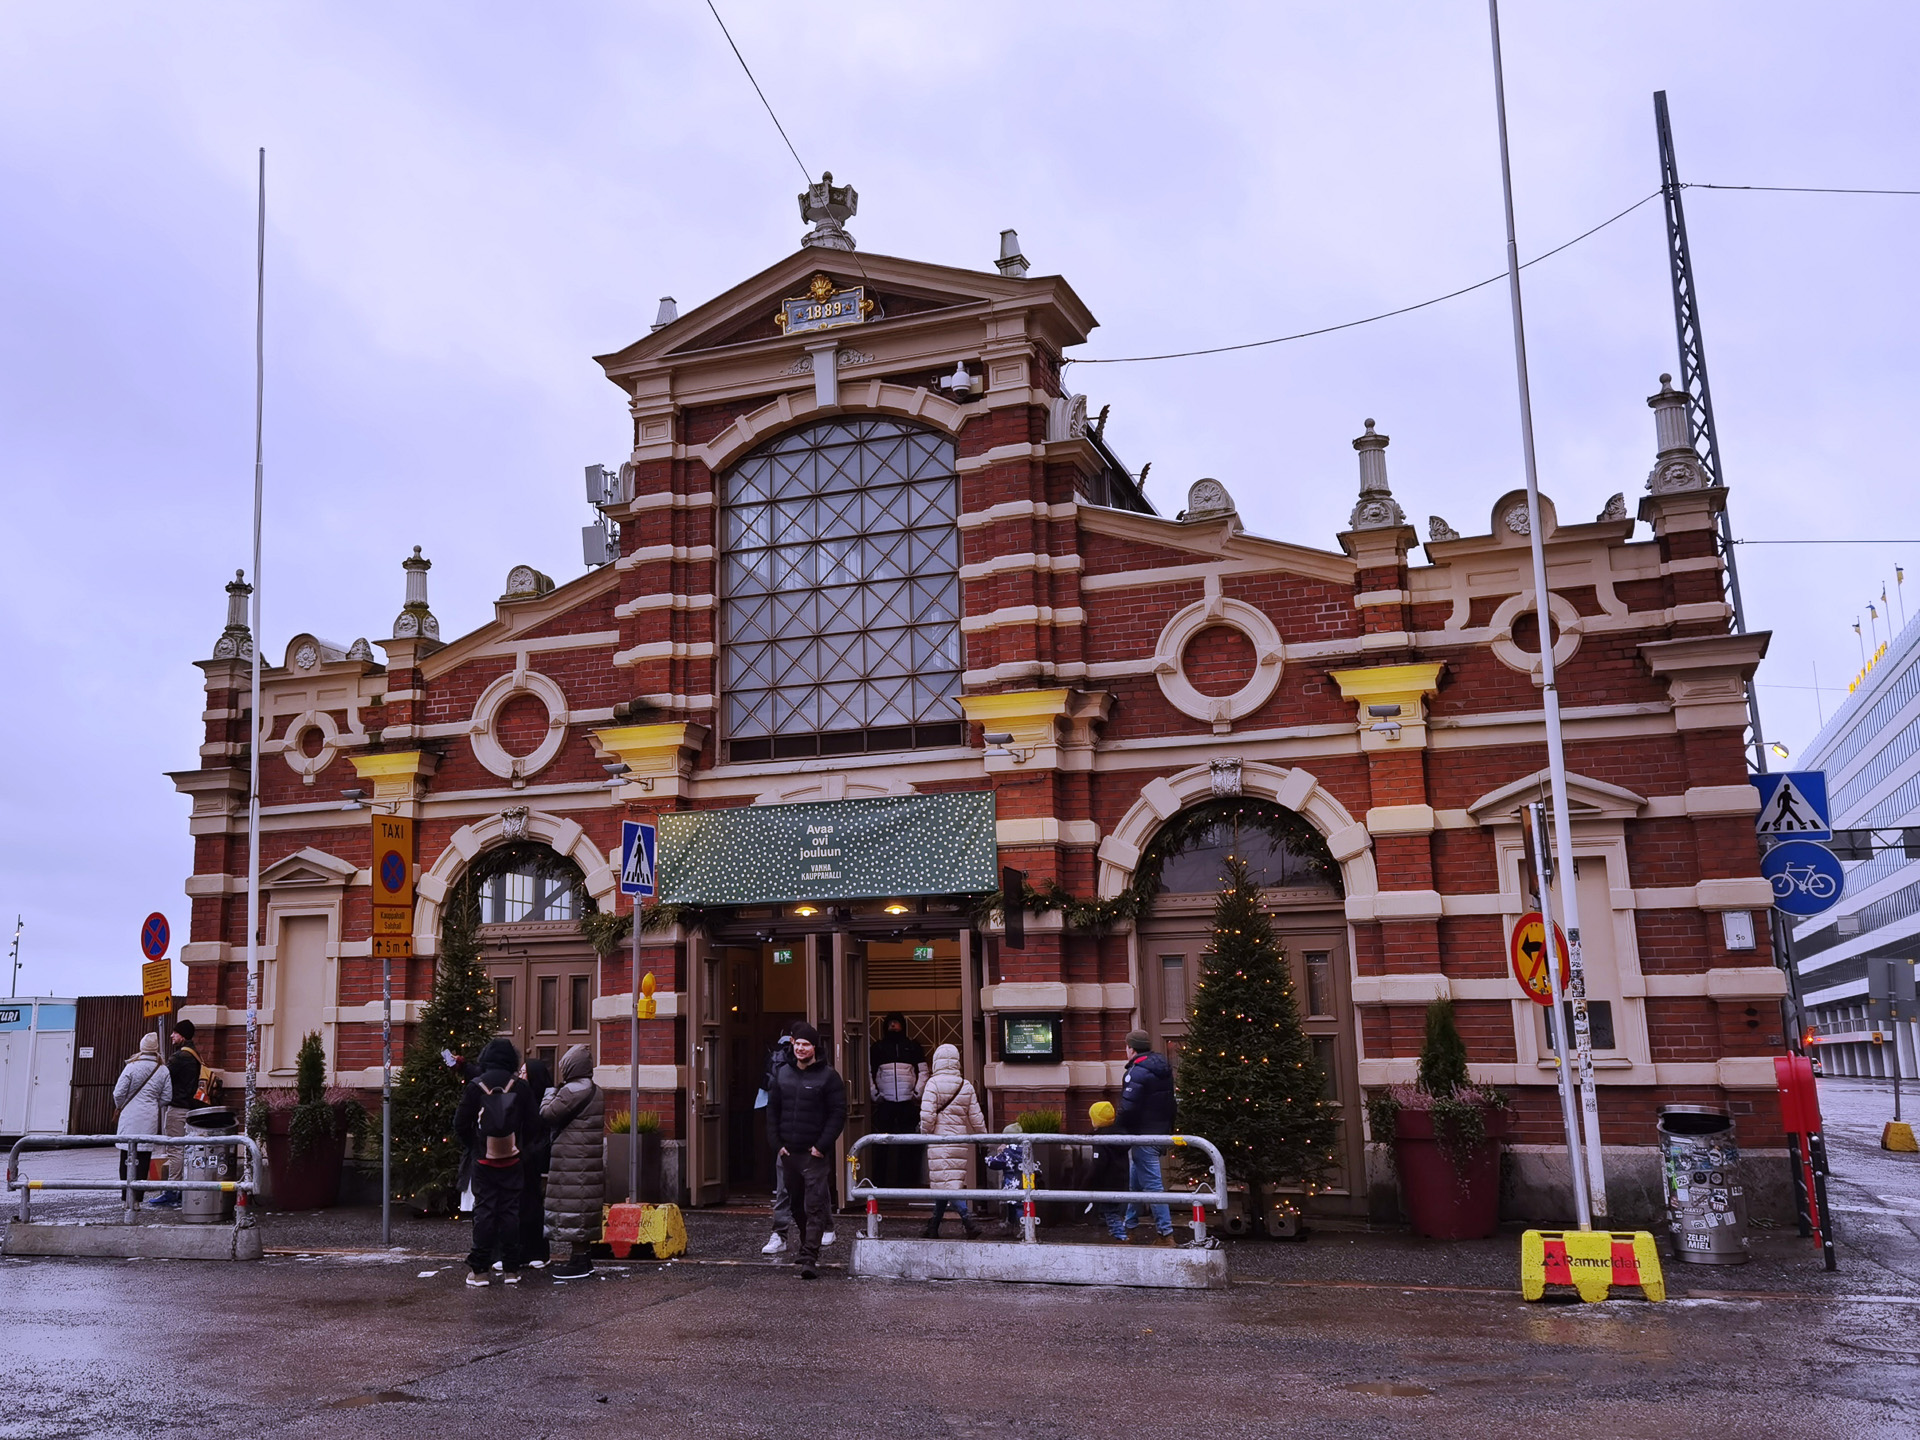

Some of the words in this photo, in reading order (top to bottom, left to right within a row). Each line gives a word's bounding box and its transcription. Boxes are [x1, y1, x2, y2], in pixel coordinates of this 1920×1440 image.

[806, 302, 842, 320] 1889
[381, 823, 404, 839] TAXI
[806, 824, 834, 835] Avaa
[812, 834, 828, 846] ovi
[800, 846, 841, 860] jouluun
[810, 863, 832, 872] VANHA
[801, 871, 842, 881] KAUPPAHALLI
[386, 940, 391, 953] 5
[392, 943, 400, 953] m
[151, 1000, 158, 1009] 14
[1688, 1241, 1711, 1250] MIEL
[1563, 1255, 1641, 1269] Ramudden
